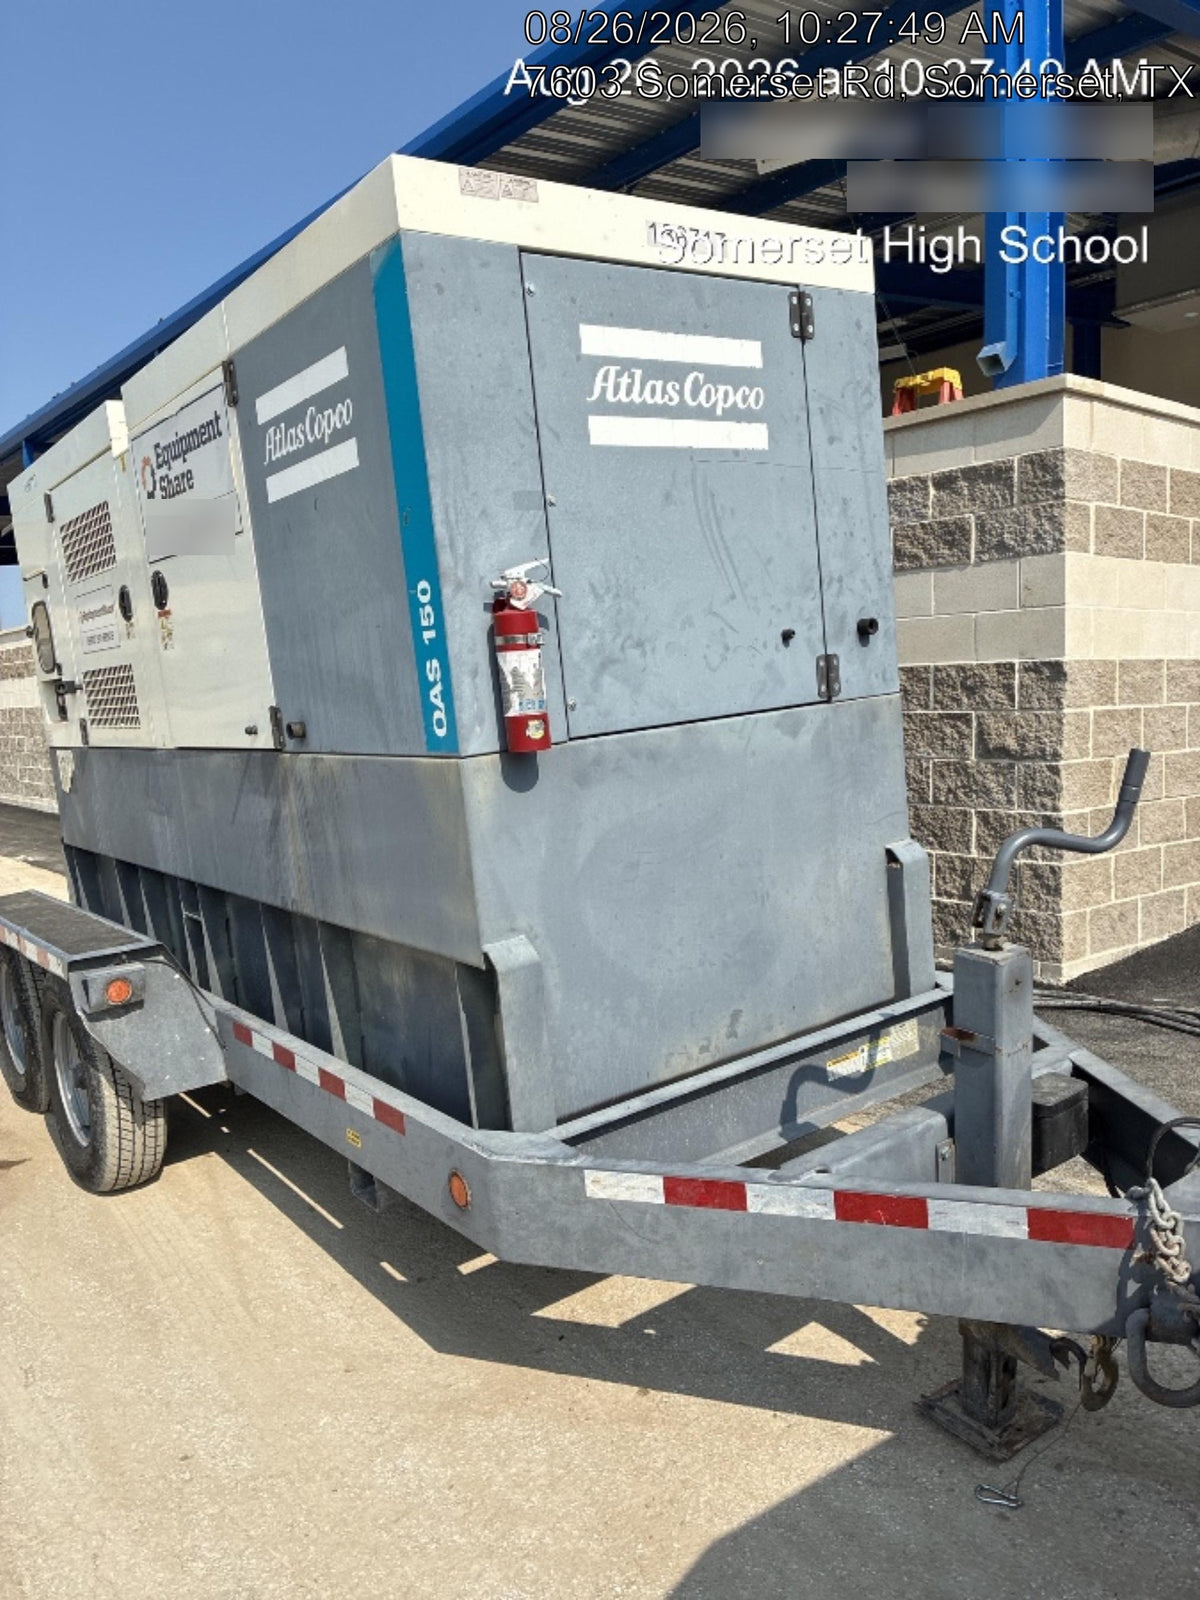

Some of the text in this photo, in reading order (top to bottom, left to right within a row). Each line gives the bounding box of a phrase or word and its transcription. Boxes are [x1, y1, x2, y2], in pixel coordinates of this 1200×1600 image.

[586, 365, 764, 416] Atlas Copco
[154, 410, 222, 471] Equipment
[264, 398, 352, 466] Atlas Copco
[159, 469, 194, 499] Share
[417, 579, 436, 645] 150
